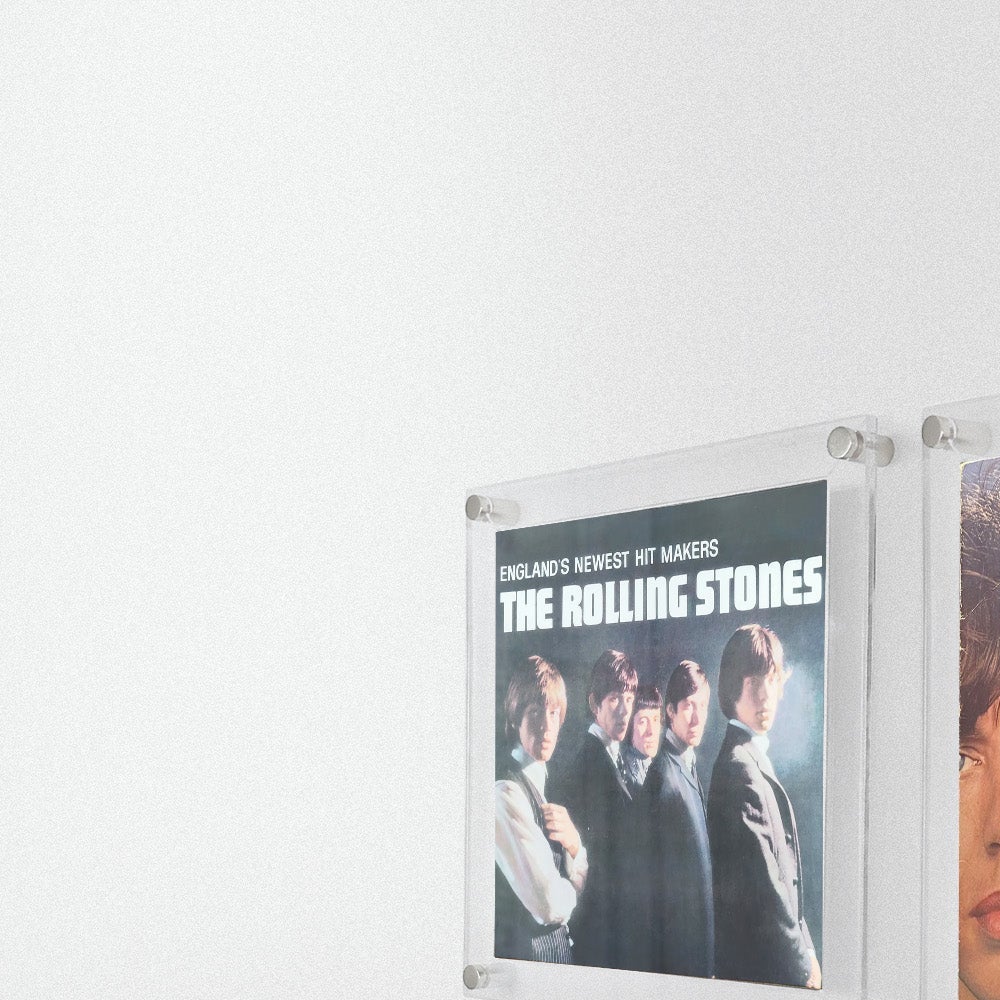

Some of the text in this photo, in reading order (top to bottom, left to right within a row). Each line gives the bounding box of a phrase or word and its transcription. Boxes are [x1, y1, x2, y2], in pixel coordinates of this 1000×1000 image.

[500, 538, 719, 582] ENGLAND'S NEWEST HIT MAKERS
[500, 555, 823, 633] THE ROLLING STONES
